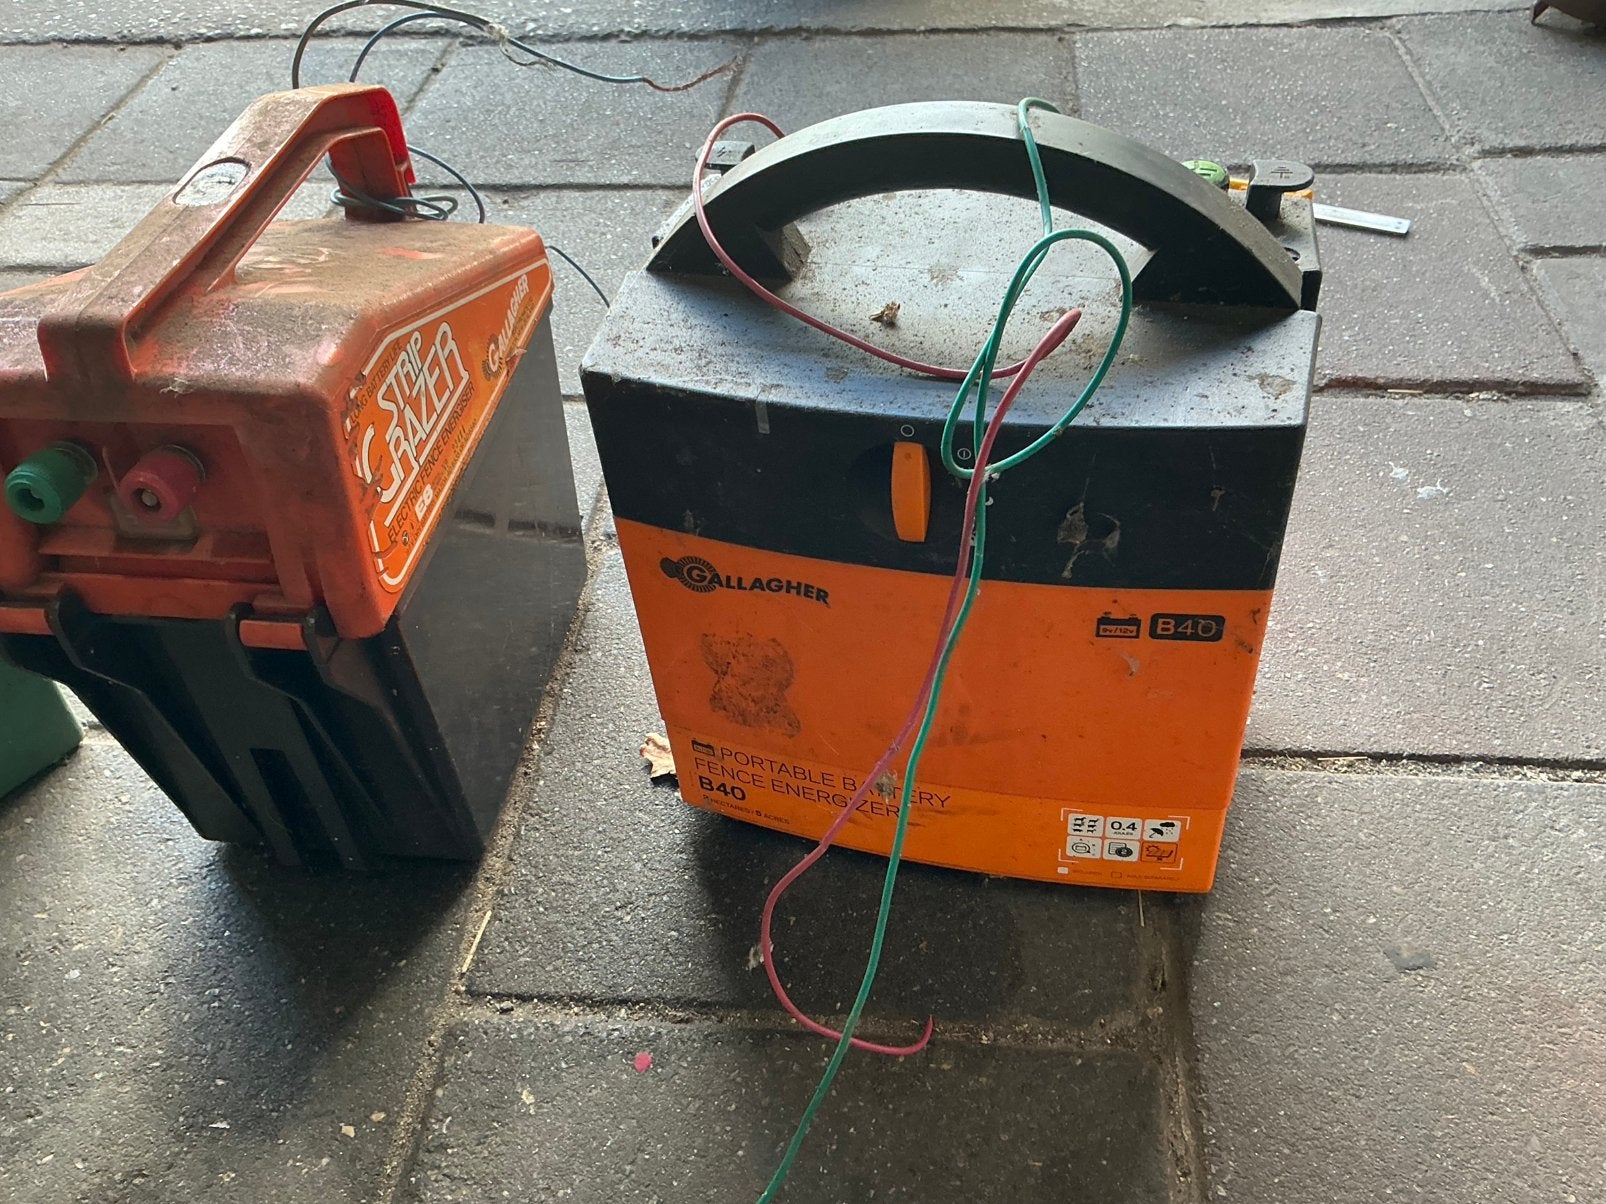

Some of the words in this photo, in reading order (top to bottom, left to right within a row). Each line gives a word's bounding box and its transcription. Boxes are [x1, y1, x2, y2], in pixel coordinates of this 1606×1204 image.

[488, 274, 529, 373] GALLAGHER
[360, 321, 470, 503] GRAZER
[377, 331, 423, 443] STRIP
[388, 480, 424, 543] ELECTRIC
[421, 437, 444, 485] FENCE
[441, 382, 476, 447] ENERGISER
[686, 564, 831, 607] GALLAGHER
[1156, 618, 1217, 637] B40
[695, 757, 766, 789] FENCE
[771, 778, 901, 818] ENERGZER
[698, 775, 746, 801] B40
[720, 747, 834, 788] PORTABLE
[1110, 821, 1138, 831] 0.4
